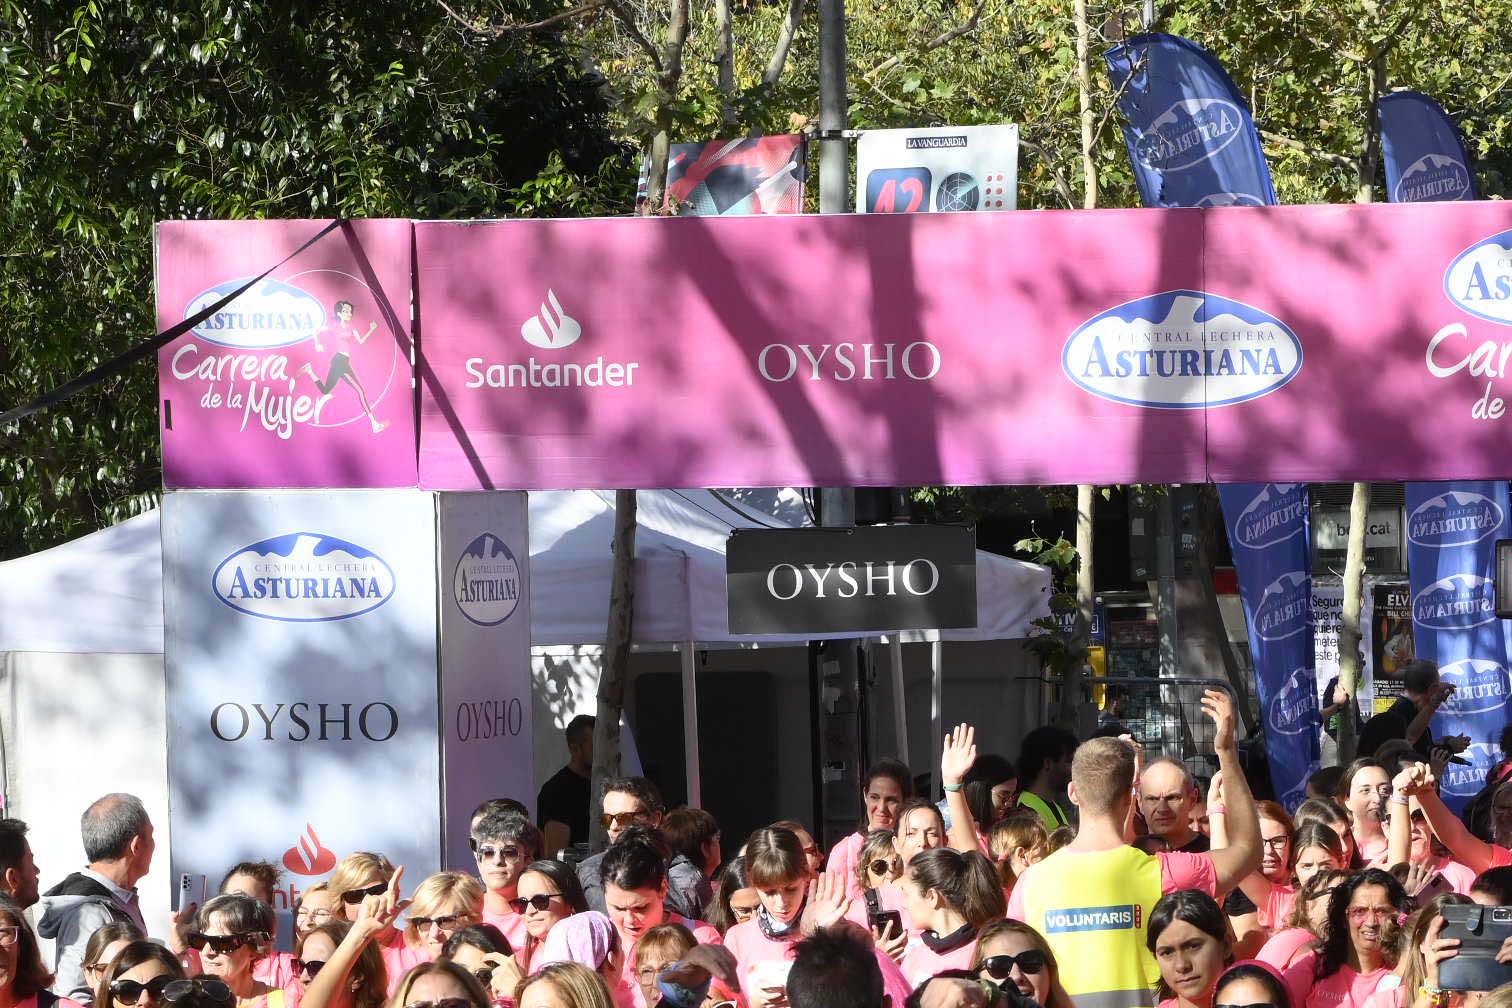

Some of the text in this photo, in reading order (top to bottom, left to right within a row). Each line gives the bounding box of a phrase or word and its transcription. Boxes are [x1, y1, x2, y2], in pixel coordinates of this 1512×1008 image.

[171, 344, 289, 382] Carrera
[466, 357, 639, 389] Santander
[758, 342, 941, 382] OYSHO
[1081, 336, 1284, 378] ASTURIANA
[200, 378, 334, 441] de la Mujer
[1472, 382, 1506, 420] de
[227, 566, 384, 600] ASTURIANA
[458, 568, 517, 603] ASTURIANA
[766, 558, 940, 601] OYSHO
[210, 701, 400, 743] OYSHO
[456, 698, 522, 742] OYSHO
[1046, 911, 1132, 929] VOLUNTARIS
